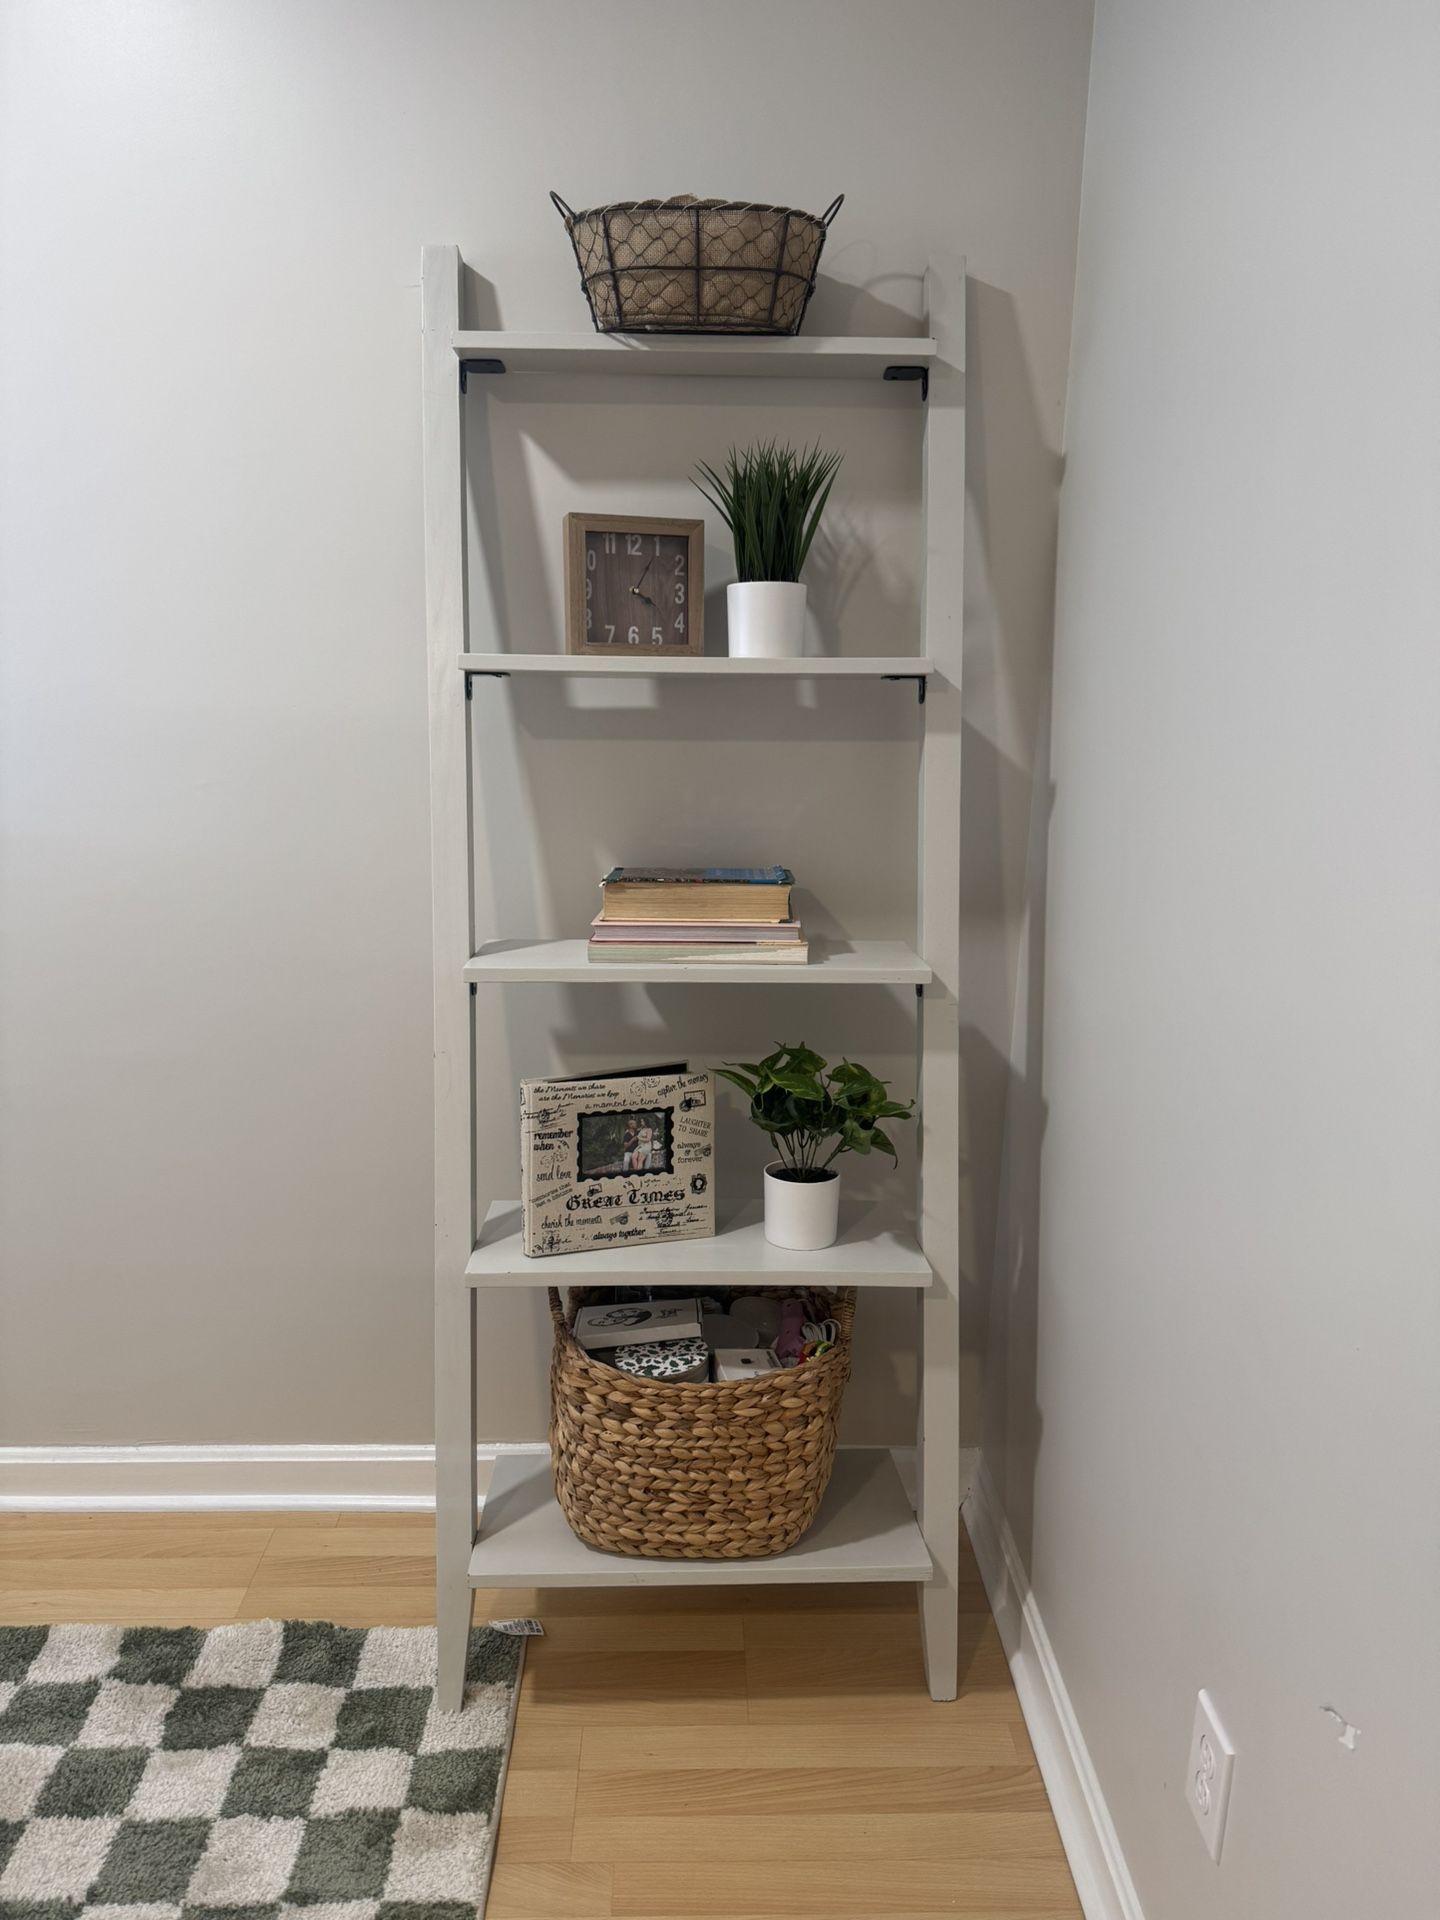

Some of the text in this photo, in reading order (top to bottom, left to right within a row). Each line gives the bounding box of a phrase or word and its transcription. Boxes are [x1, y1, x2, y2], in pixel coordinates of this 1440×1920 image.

[602, 533, 616, 554] 11
[625, 534, 642, 556] 12
[653, 536, 660, 556] 1
[674, 554, 685, 576] 2
[674, 583, 685, 604] 3
[674, 612, 685, 633] 4
[604, 624, 615, 643] 7
[628, 626, 639, 644] 6
[651, 626, 663, 645] 5
[593, 1099, 627, 1108] moment
[678, 1124, 709, 1137] TO SHARE
[680, 1116, 711, 1130] LAUGHTER
[534, 1128, 574, 1140] remember
[533, 1141, 555, 1151] when
[677, 1156, 703, 1164] forever
[541, 1214, 563, 1229] cherish
[564, 1213, 574, 1227] the
[592, 1227, 646, 1242] always together
